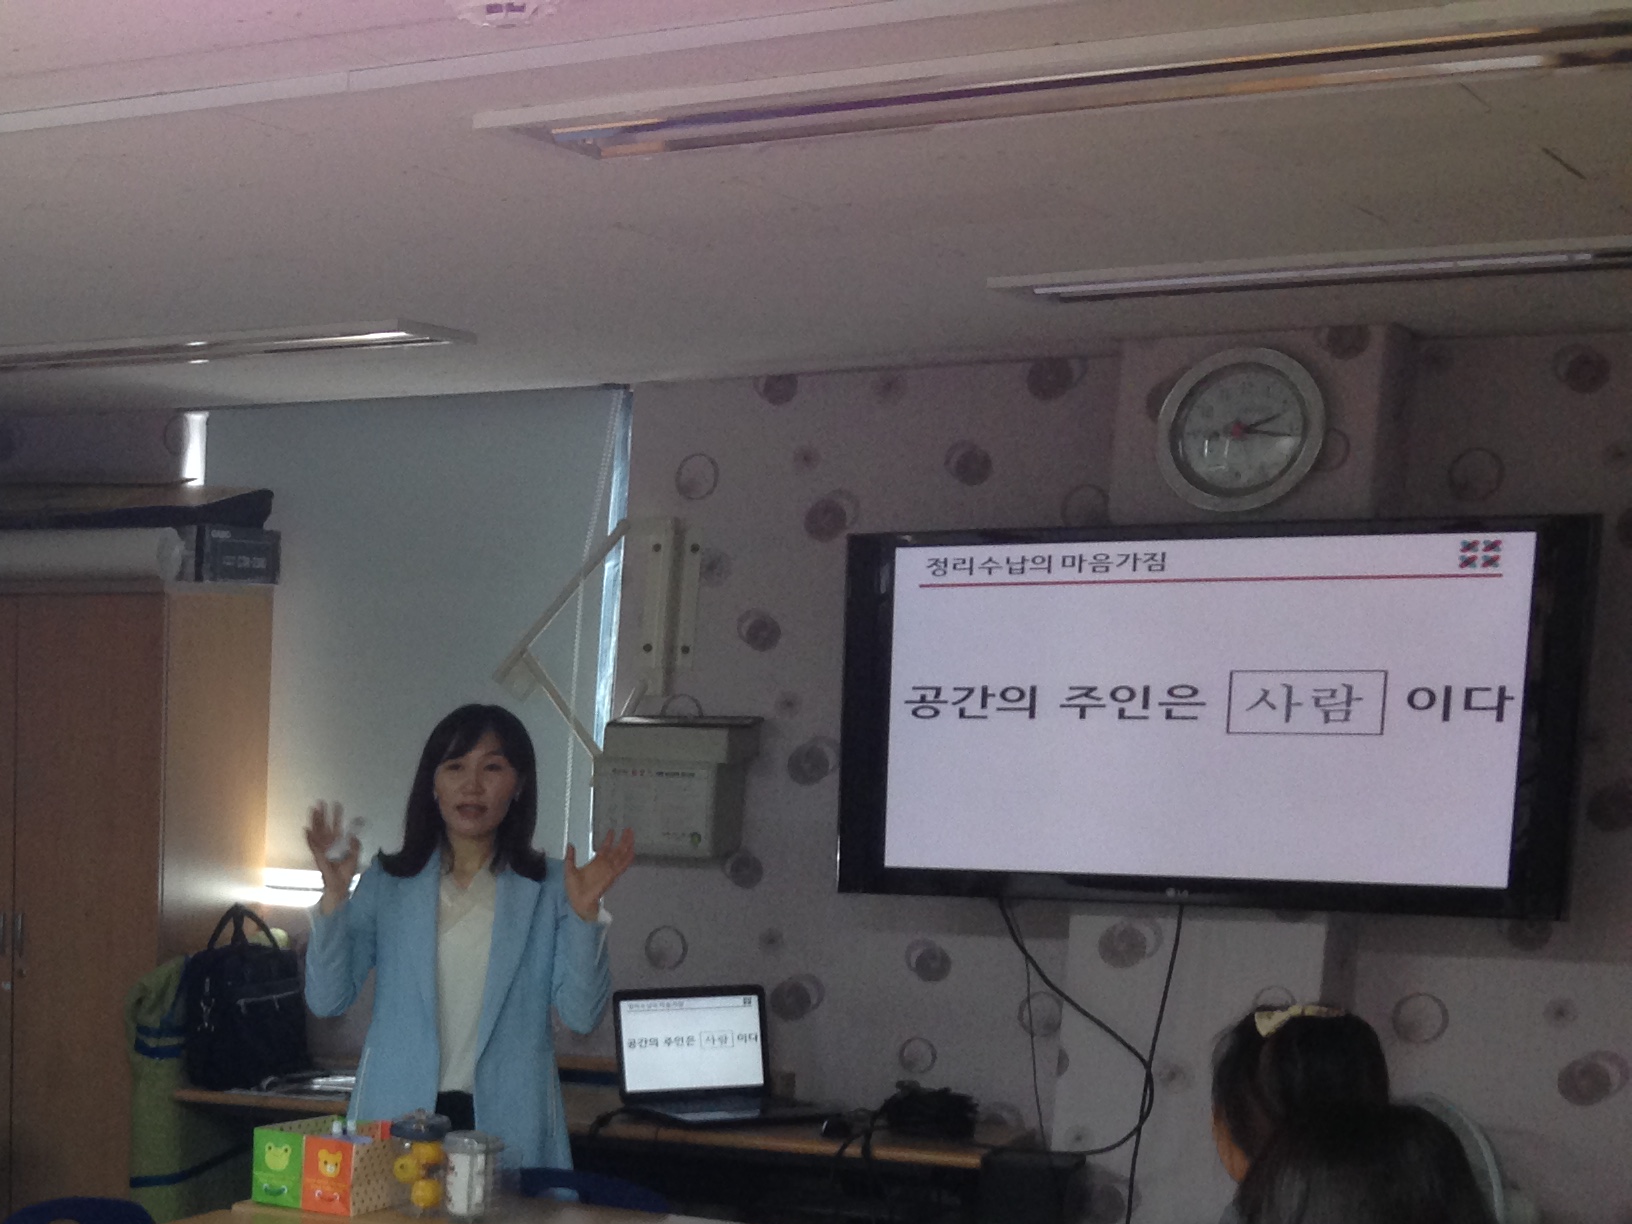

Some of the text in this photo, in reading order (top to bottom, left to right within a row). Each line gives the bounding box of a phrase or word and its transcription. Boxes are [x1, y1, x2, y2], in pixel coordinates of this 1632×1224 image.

[926, 551, 1167, 577] 정리수납의 마음가짐
[903, 682, 1515, 725] 공간의 주인은 사람 이다
